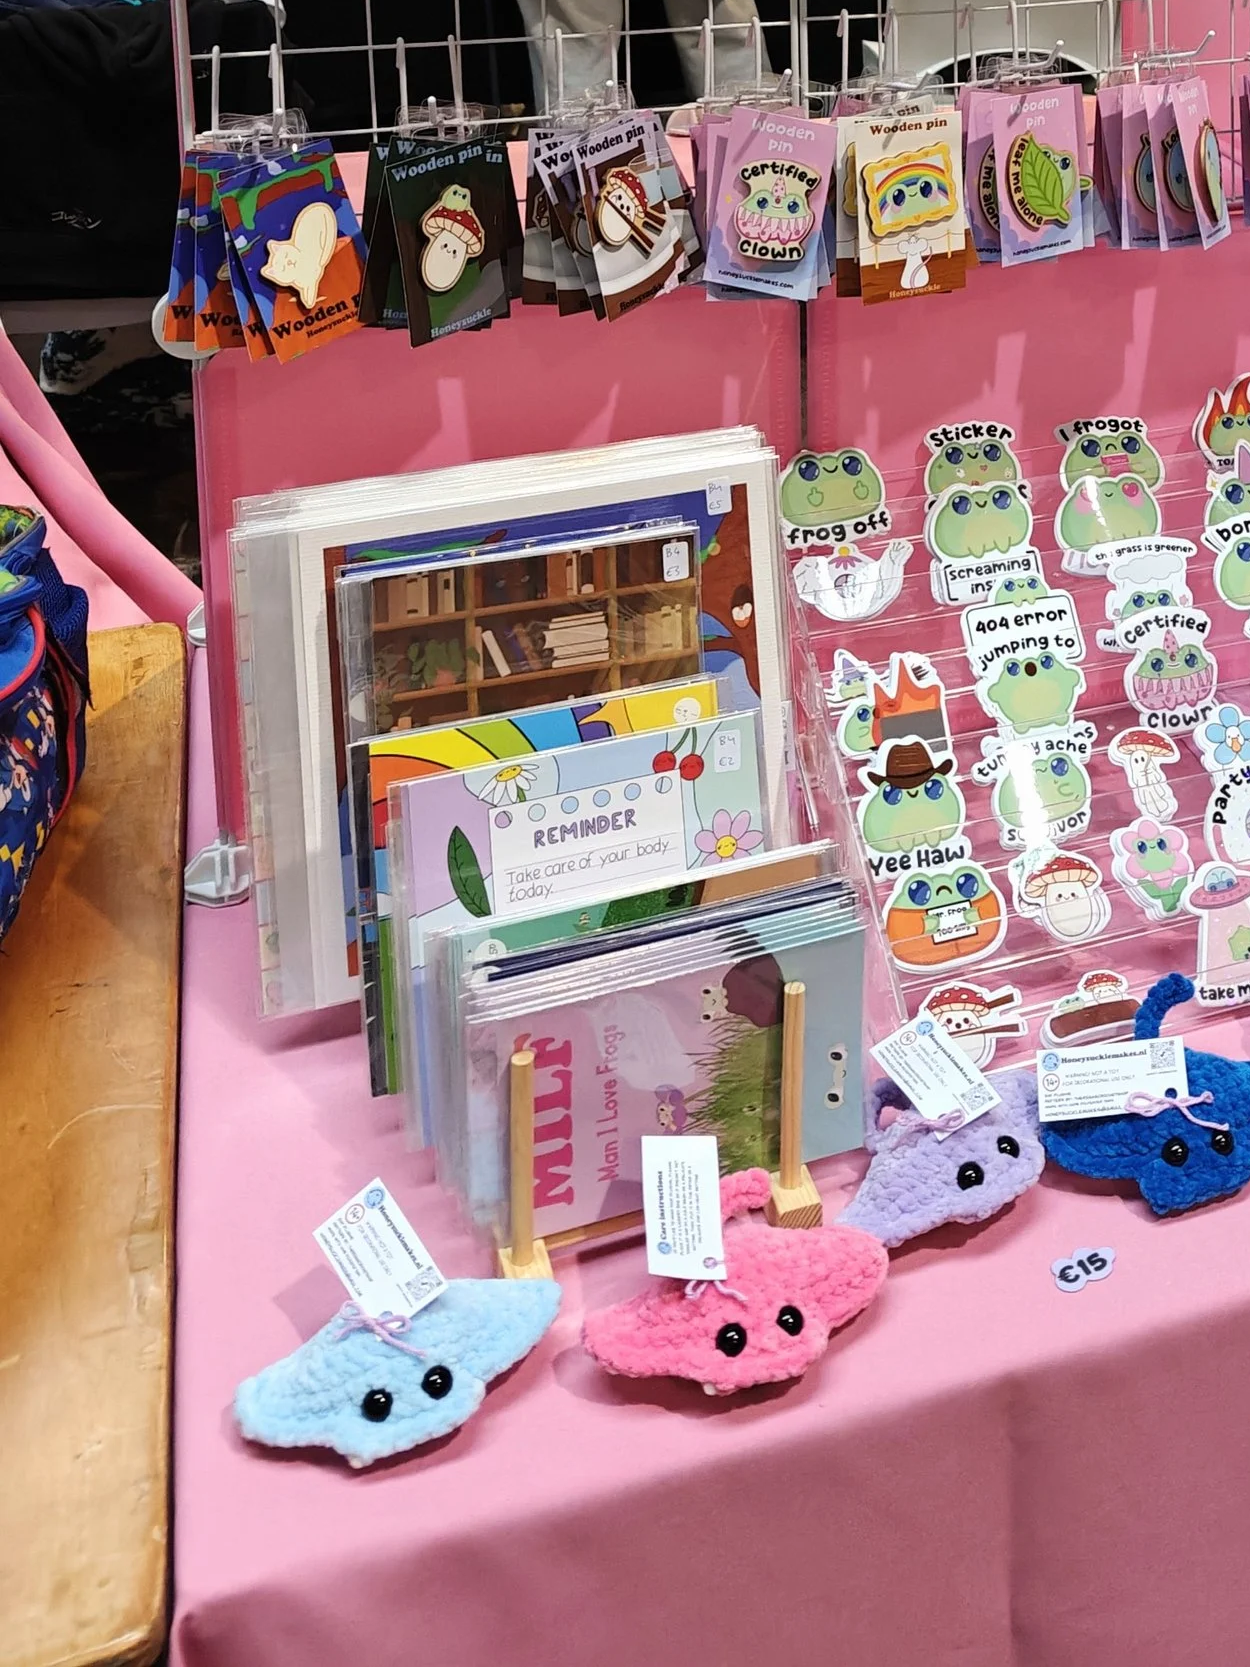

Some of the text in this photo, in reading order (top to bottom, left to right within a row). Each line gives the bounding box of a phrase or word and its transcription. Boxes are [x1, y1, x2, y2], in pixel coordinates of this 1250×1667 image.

[626, 124, 646, 146] pin
[458, 144, 482, 165] pin
[740, 162, 818, 188] Certified
[1009, 137, 1043, 226] leaf me alone
[739, 240, 801, 258] Clown
[930, 424, 1012, 447] Sticker
[1073, 419, 1144, 435] frogot
[786, 510, 889, 544] frog off
[666, 547, 680, 557] B4
[1116, 544, 1142, 556] grass
[1154, 543, 1194, 553] greener
[666, 565, 680, 576] €3
[949, 556, 1032, 582] screaming
[975, 608, 1068, 634] 404 error
[1124, 613, 1208, 645] Certified
[978, 635, 1049, 671] jumping
[1054, 634, 1075, 648] to
[1044, 739, 1088, 754] ache
[718, 755, 734, 766] €2
[534, 808, 637, 849] REMINDER
[506, 837, 669, 884] Take care of your body
[869, 844, 965, 876] Yee Haw
[509, 882, 554, 902] today.
[1199, 986, 1235, 1000] take
[1061, 1050, 1147, 1065] Honeysucklemakes.nl
[596, 1024, 626, 1183] Man Love Frogs
[1056, 1251, 1108, 1284] €15
